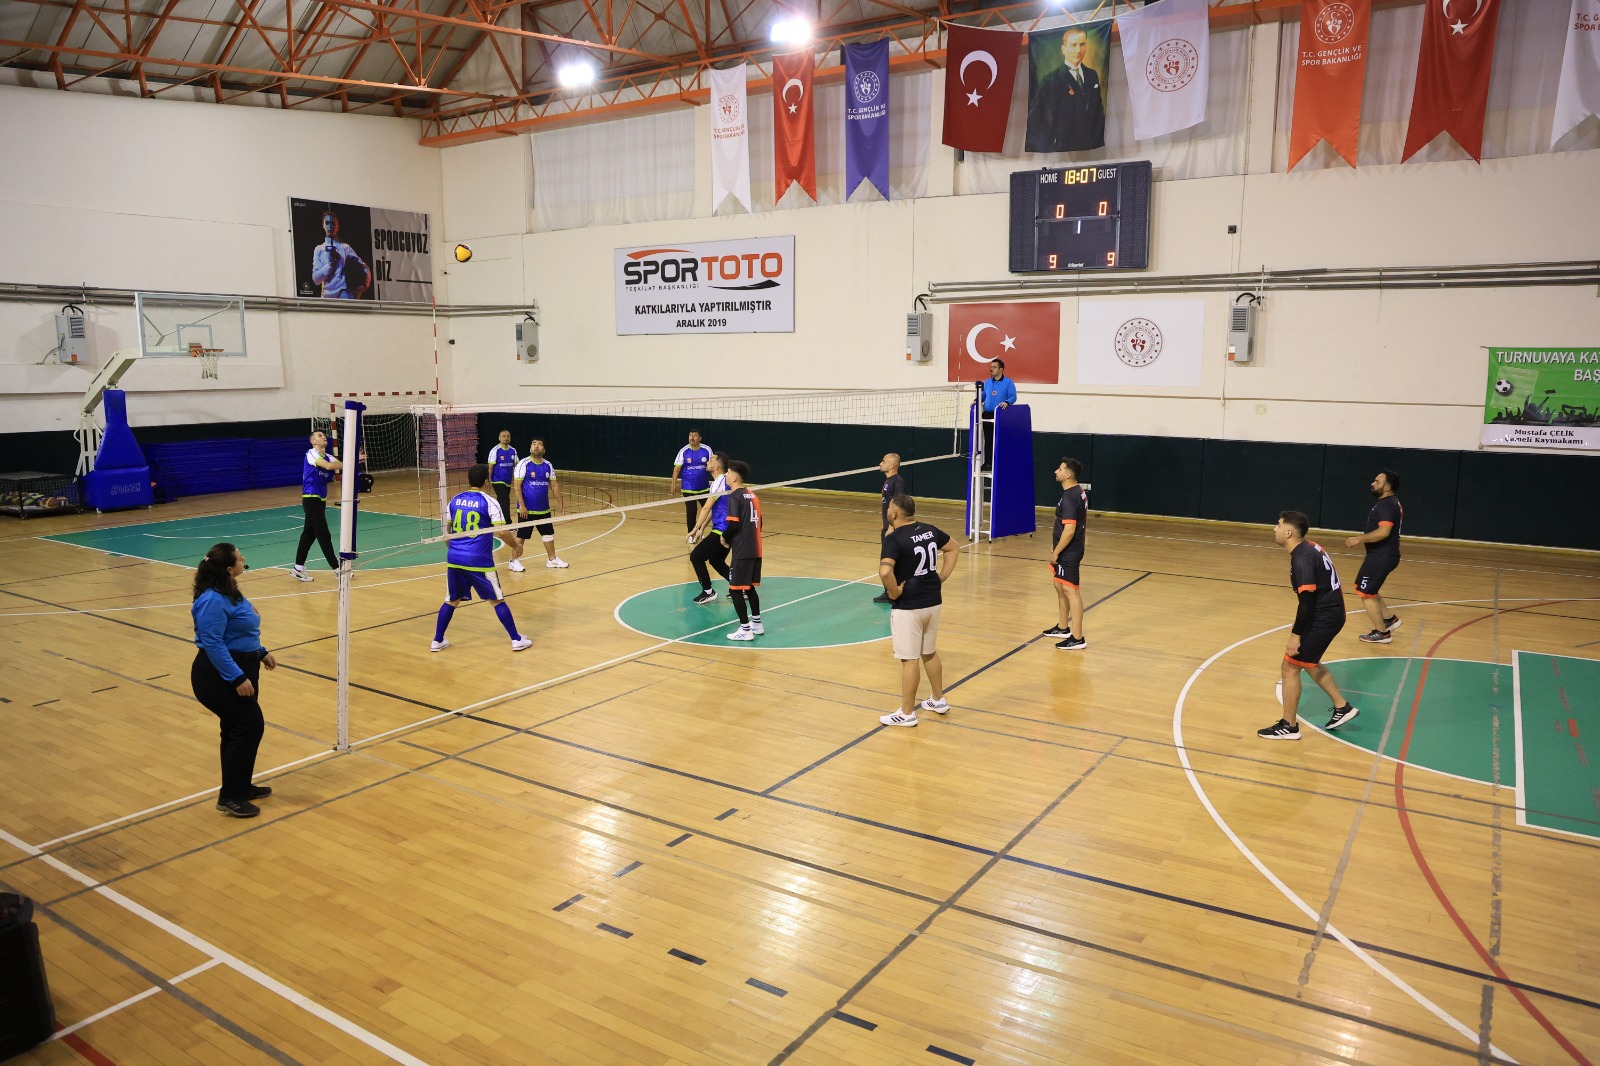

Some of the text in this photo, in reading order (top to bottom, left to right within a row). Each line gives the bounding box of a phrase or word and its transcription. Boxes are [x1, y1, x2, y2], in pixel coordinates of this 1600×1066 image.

[1318, 47, 1350, 56] GENÇLİK
[1322, 53, 1362, 64] BAKANLIĞI
[1040, 172, 1058, 183] HOME
[1064, 168, 1096, 184] 18:07
[1098, 168, 1116, 180] GUEST
[1056, 204, 1064, 218] 0
[1098, 202, 1107, 216] 0
[374, 228, 428, 254] SPORCUYUZ
[1049, 254, 1056, 268] 9
[1107, 252, 1115, 266] 9
[376, 256, 392, 282] BİZ
[635, 300, 772, 314] KATKILARIYLA YAPTIRILMIŞTIR
[676, 318, 726, 328] ARALIK 2019
[1496, 352, 1576, 364] TURNUVAYA
[456, 498, 478, 508] BABA
[750, 500, 758, 528] 4
[453, 508, 480, 538] 48
[910, 531, 934, 543] TAMER
[914, 542, 938, 576] 20
[1360, 579, 1368, 590] 5
